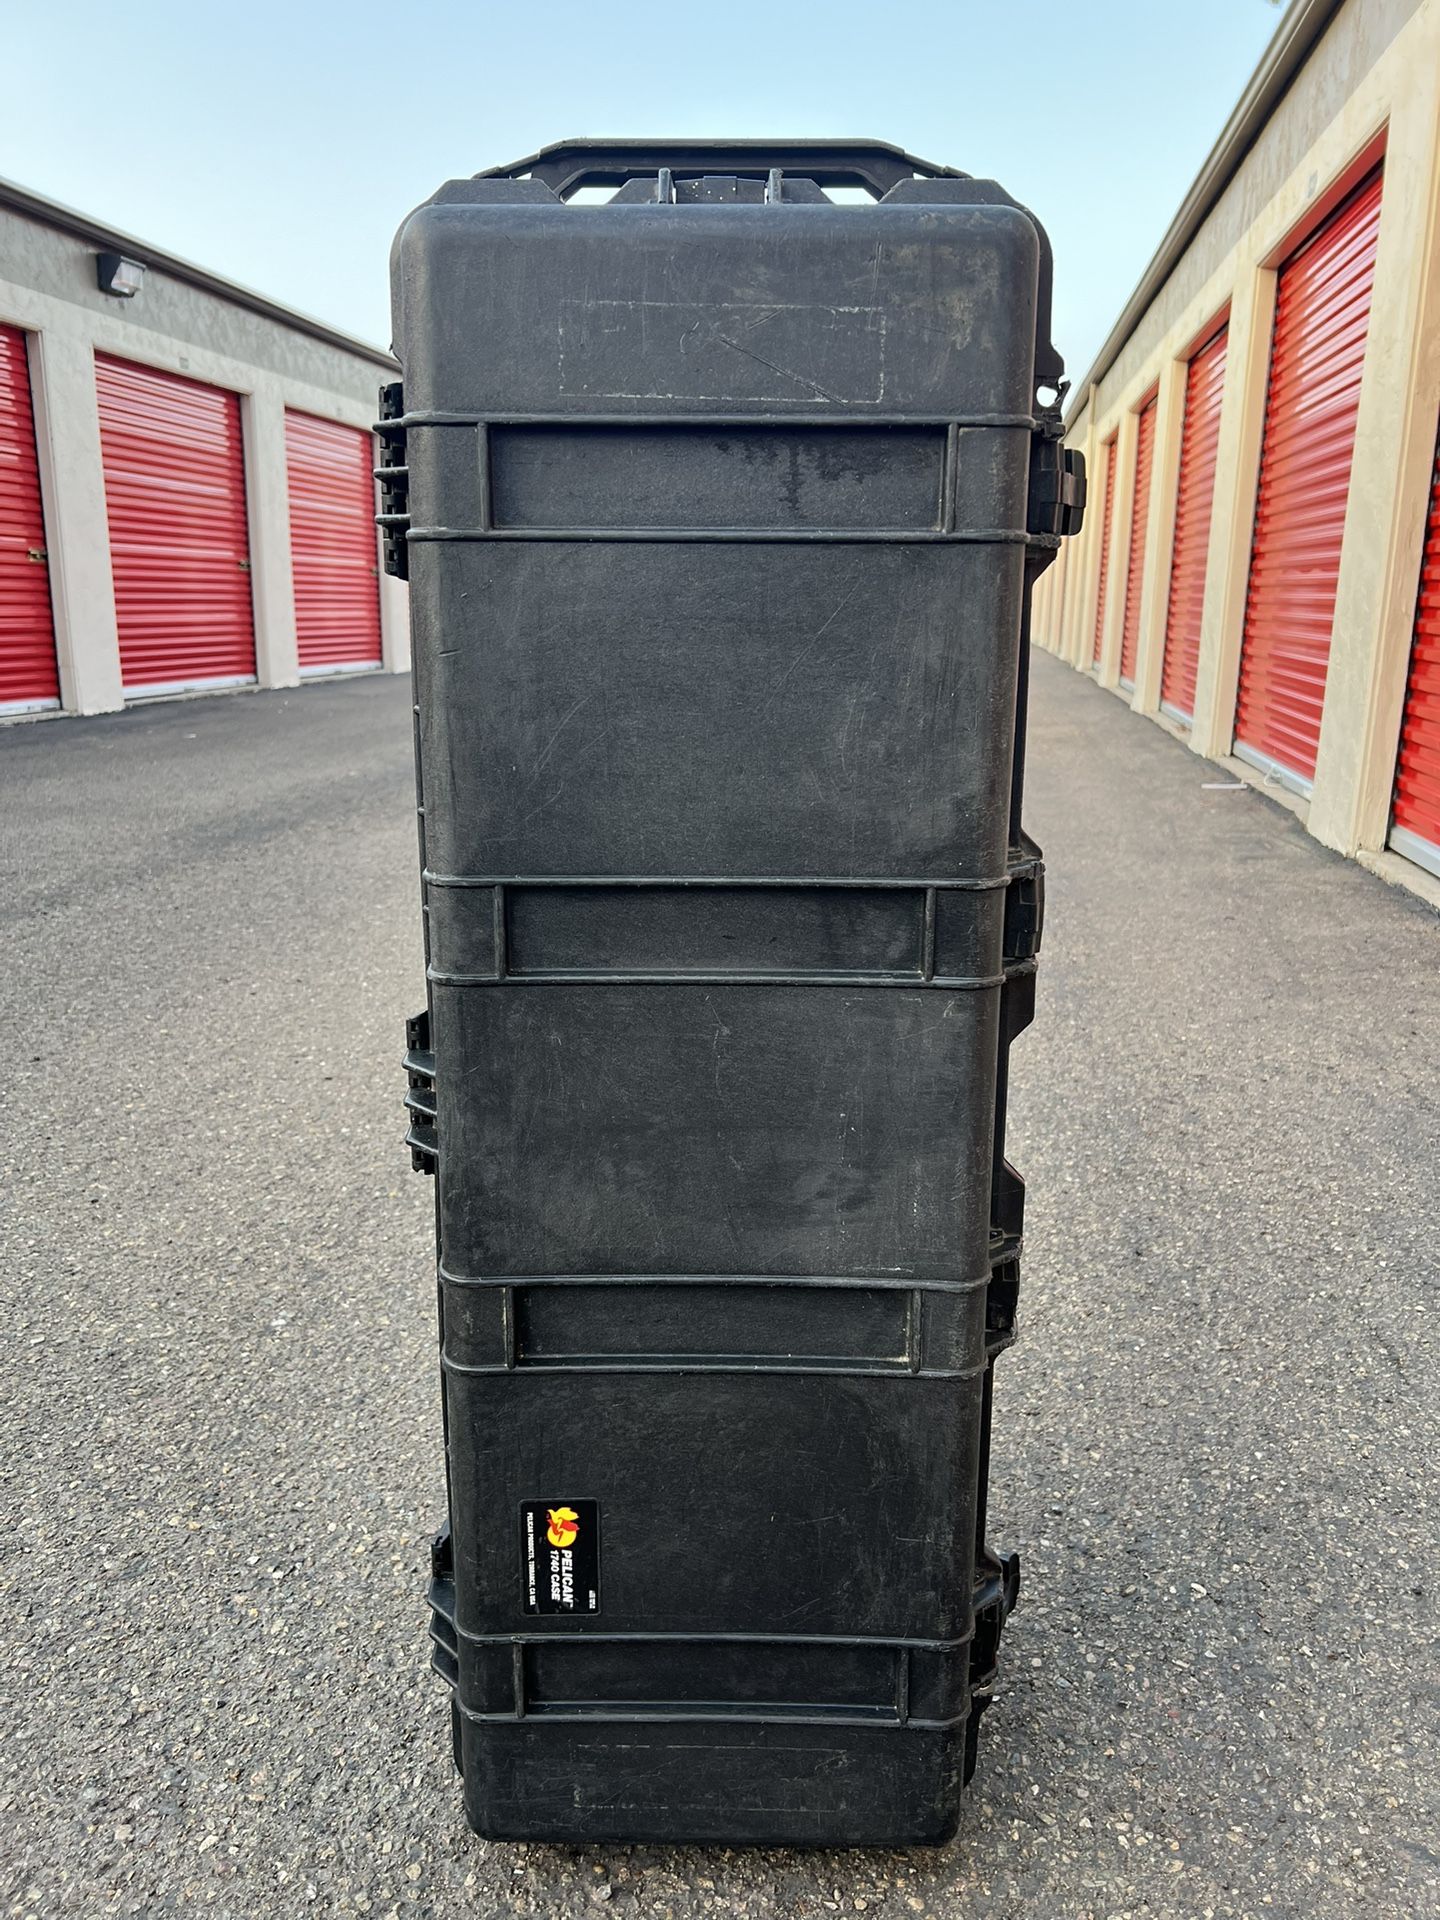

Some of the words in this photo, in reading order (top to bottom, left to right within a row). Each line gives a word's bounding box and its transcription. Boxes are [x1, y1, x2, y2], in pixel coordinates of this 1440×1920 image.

[550, 1550, 559, 1572] 1740
[550, 1574, 560, 1601] CASE
[561, 1549, 573, 1603] PELICAN
